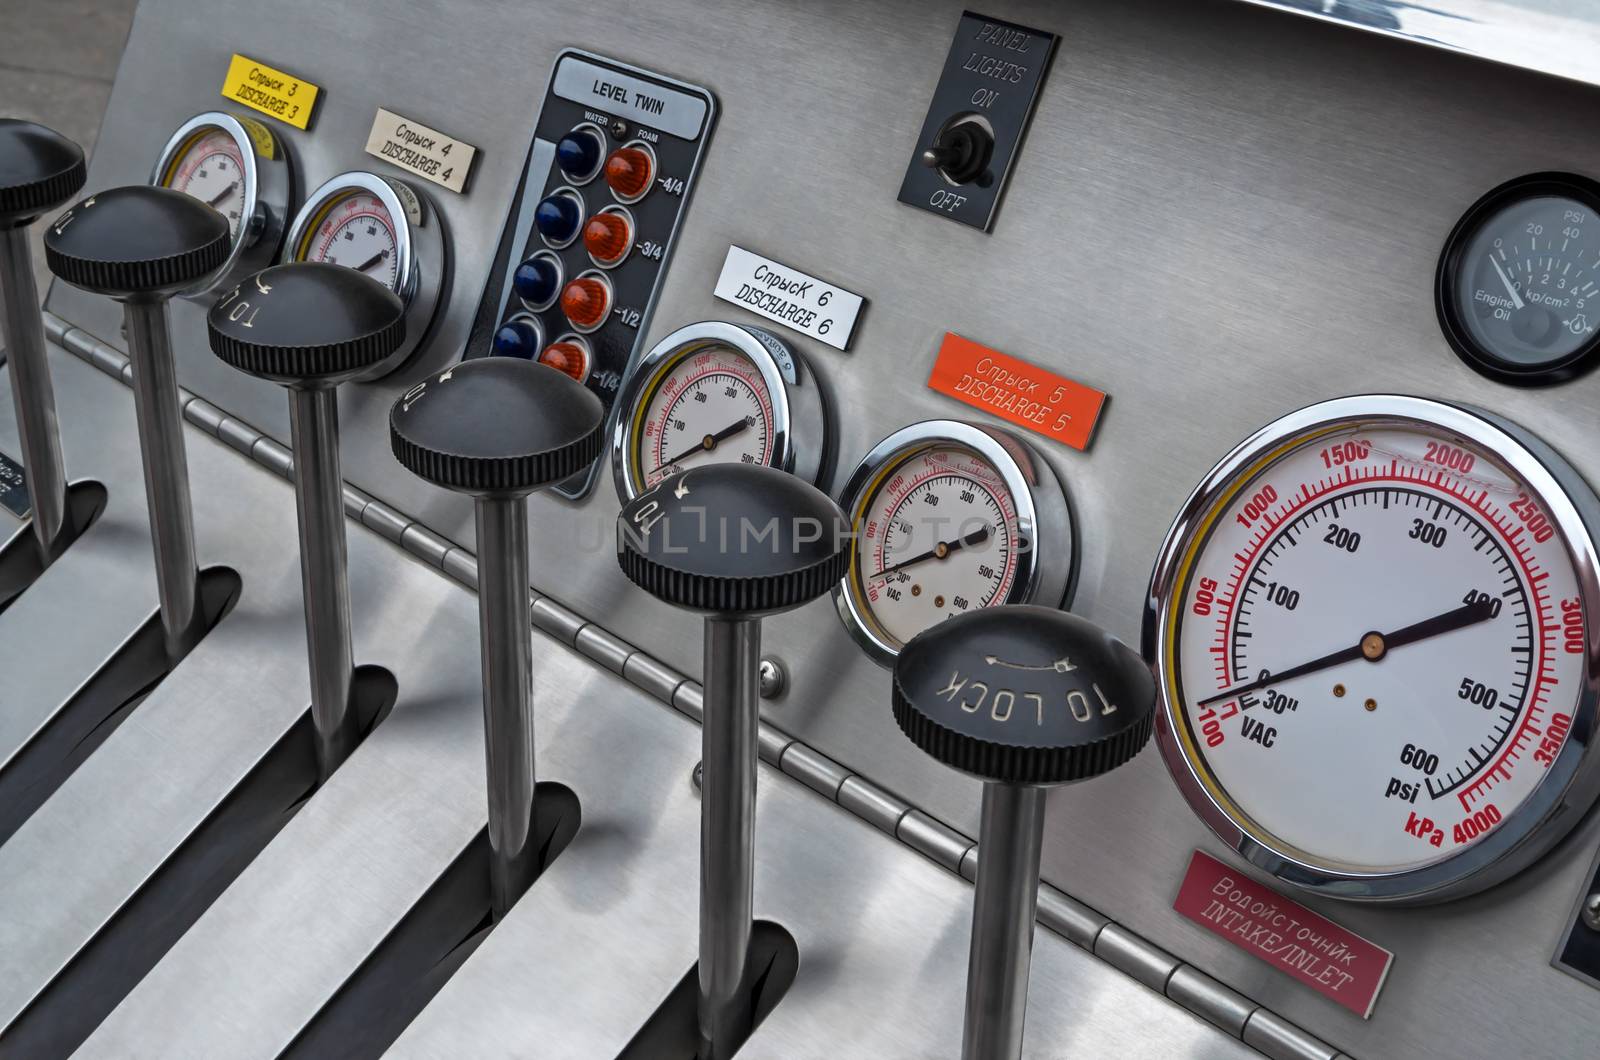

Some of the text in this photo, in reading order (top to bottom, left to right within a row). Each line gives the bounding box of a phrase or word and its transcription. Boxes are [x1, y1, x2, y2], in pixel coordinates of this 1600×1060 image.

[975, 23, 1032, 54] PANEL
[249, 67, 298, 97] Спрыск 3
[962, 53, 1027, 84] LIGHTS
[236, 84, 299, 119] DISCHARGE 3
[592, 79, 665, 115] LEVEL TWIN
[971, 88, 999, 109] ON
[584, 111, 609, 126] WATER
[395, 124, 453, 157] Спрыск 4
[637, 129, 659, 143] FOAM
[380, 140, 453, 181] DISCHARGE 4
[929, 189, 967, 212] OFF
[1563, 210, 1586, 224] PSI
[1494, 223, 1580, 248] 0 20 40
[817, 291, 833, 306] 6
[1474, 289, 1514, 309] Engine
[1527, 275, 1533, 284] 1
[1541, 274, 1549, 285] 2
[1557, 279, 1565, 289] 3
[1570, 286, 1579, 297] 4
[1576, 299, 1585, 309] 5
[735, 283, 834, 334] DISCHARGE 6
[1494, 307, 1511, 321] Oil
[663, 377, 678, 396] 1000
[725, 387, 738, 398] 300
[976, 358, 1067, 404] Спрыск 5
[694, 392, 707, 403] 200
[954, 374, 1072, 431] DISCHARGE 5
[645, 421, 655, 437] 500
[674, 419, 686, 431] 100
[741, 453, 754, 464] 500
[1320, 440, 1372, 469] 1500
[1423, 442, 1475, 473] 2000
[887, 475, 904, 496] 1000
[924, 492, 939, 506] 200
[960, 490, 975, 504] 300
[1236, 484, 1279, 529] 1000
[1509, 492, 1554, 544] 2500
[866, 520, 877, 538] 500
[900, 523, 913, 536] 100
[1323, 523, 1361, 553] 200
[1408, 518, 1447, 548] 300
[978, 565, 994, 579] 500
[886, 586, 902, 602] VAC
[953, 596, 969, 610] 600
[1193, 577, 1218, 616] 500
[1266, 582, 1300, 611] 100
[1561, 597, 1584, 654] 3000
[935, 671, 1118, 726] TO LOCK
[1458, 677, 1498, 710] 500
[1241, 715, 1277, 748] VAC
[1533, 712, 1572, 769] 3500
[1400, 743, 1439, 776] 600
[1385, 777, 1420, 804] psi
[1404, 812, 1445, 848] kPa
[1452, 804, 1502, 844] 4000
[1200, 899, 1354, 991] INTAKE/INLET
